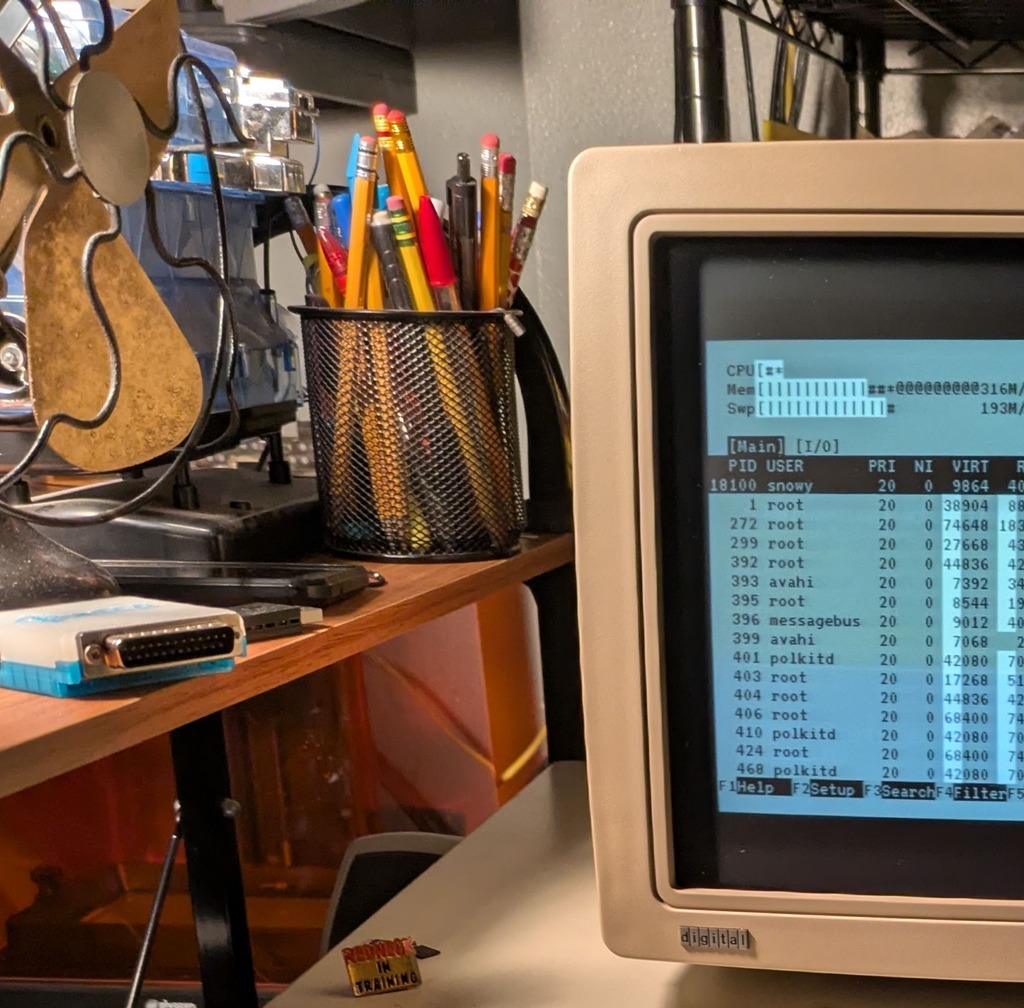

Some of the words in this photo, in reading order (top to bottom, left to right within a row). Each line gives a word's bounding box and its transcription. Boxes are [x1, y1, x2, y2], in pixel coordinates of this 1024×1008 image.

[731, 439, 783, 454] [Main]
[729, 459, 756, 472] PID
[767, 460, 803, 472] USER
[869, 460, 895, 472] PRI
[915, 460, 932, 472] NI
[953, 460, 989, 472] VIRT
[711, 479, 756, 491] 18100
[768, 482, 813, 494] snowy
[879, 479, 895, 492] 20
[953, 480, 989, 492] 9864
[768, 499, 803, 510] root
[731, 517, 757, 529] 272
[768, 518, 803, 530] root
[944, 519, 988, 531] 74648
[731, 537, 758, 549] 299
[769, 538, 804, 549] root
[731, 556, 757, 568] 392
[769, 557, 804, 568] root
[732, 575, 758, 587] 393
[769, 576, 813, 588] avahi
[732, 594, 759, 606] 395
[770, 595, 805, 607] root
[733, 613, 760, 625] 396
[770, 615, 860, 629] messagebus
[733, 632, 760, 644] 399
[771, 634, 815, 645] avahi
[733, 651, 760, 663] 401
[771, 652, 834, 666] polkitd
[734, 670, 761, 682] 403
[772, 672, 806, 683] root
[773, 728, 835, 741] polkitd
[737, 763, 763, 774] 468
[774, 765, 836, 778] polkitd
[681, 932, 745, 945] digital
[377, 961, 391, 973] IN
[356, 972, 418, 993] TRAINING
